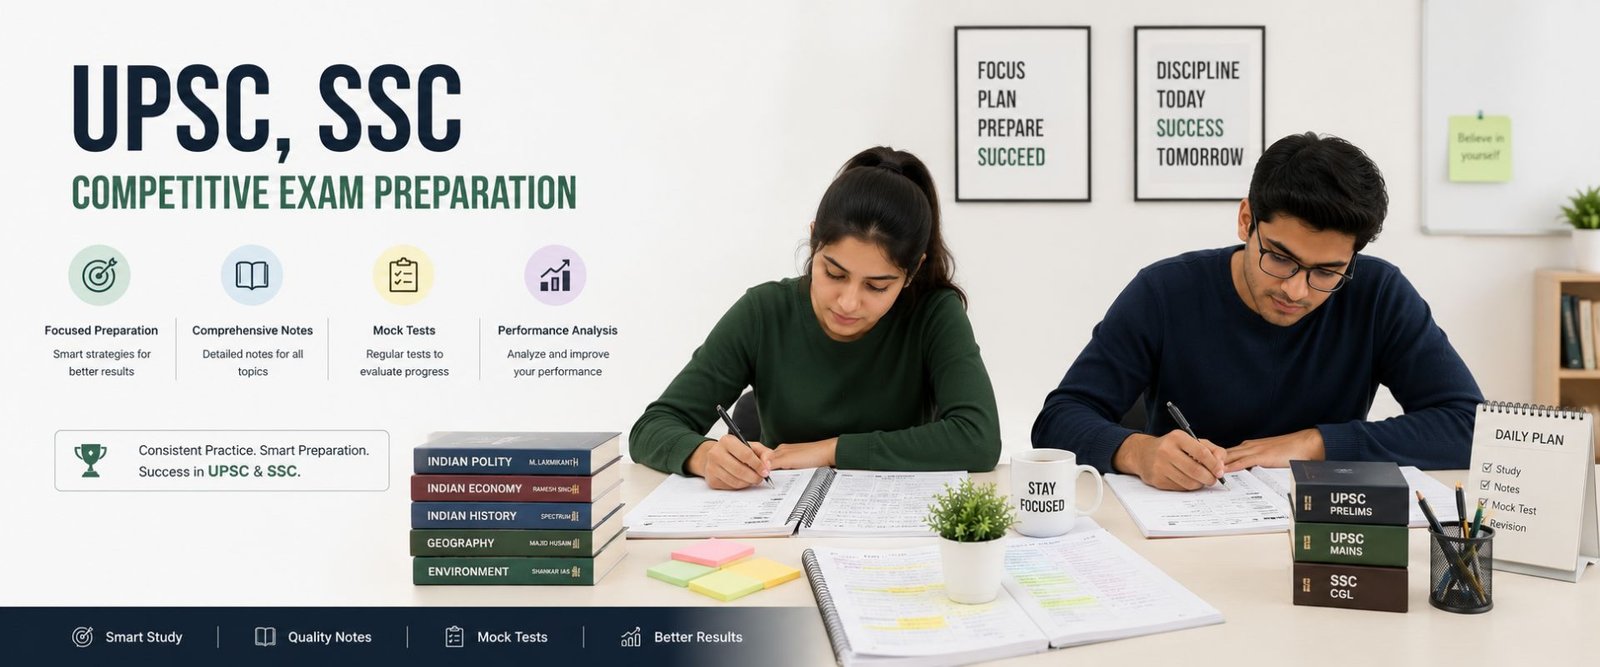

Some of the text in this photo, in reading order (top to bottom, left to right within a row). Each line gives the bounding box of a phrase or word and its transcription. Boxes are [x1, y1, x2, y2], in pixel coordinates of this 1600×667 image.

[978, 60, 1026, 80] FOCUS
[1156, 60, 1240, 80] DISCIPLINE
[978, 90, 1016, 108] PLAN
[1156, 90, 1206, 108] TODAY
[978, 118, 1044, 138] PREPARE
[1156, 118, 1224, 138] SUCCESS
[1458, 132, 1505, 144] Believe in
[978, 148, 1046, 166] SUCCEED
[1156, 148, 1244, 166] TOMORROW
[1460, 150, 1500, 162] yourself
[1496, 428, 1564, 446] DAILY PLAN
[428, 456, 512, 466] INDIAN POLITY
[1496, 464, 1522, 478] Study
[428, 484, 522, 494] INDIAN ECONOMY
[1028, 482, 1056, 496] STAY
[1494, 482, 1520, 494] Notes
[1330, 492, 1366, 504] UPSC
[1020, 498, 1064, 512] FOCUSED
[1330, 506, 1372, 516] PRELIMS
[1492, 500, 1536, 516] Mock Test
[428, 510, 518, 520] INDIAN HISTORY
[1490, 518, 1527, 532] Revision
[426, 538, 494, 548] GEOGRAPHY
[1330, 532, 1364, 544] UPSC
[1330, 546, 1362, 556] MAINS
[428, 566, 510, 576] ENVIRONMENT
[1330, 575, 1358, 588] SSC
[1330, 588, 1354, 600] CGL
